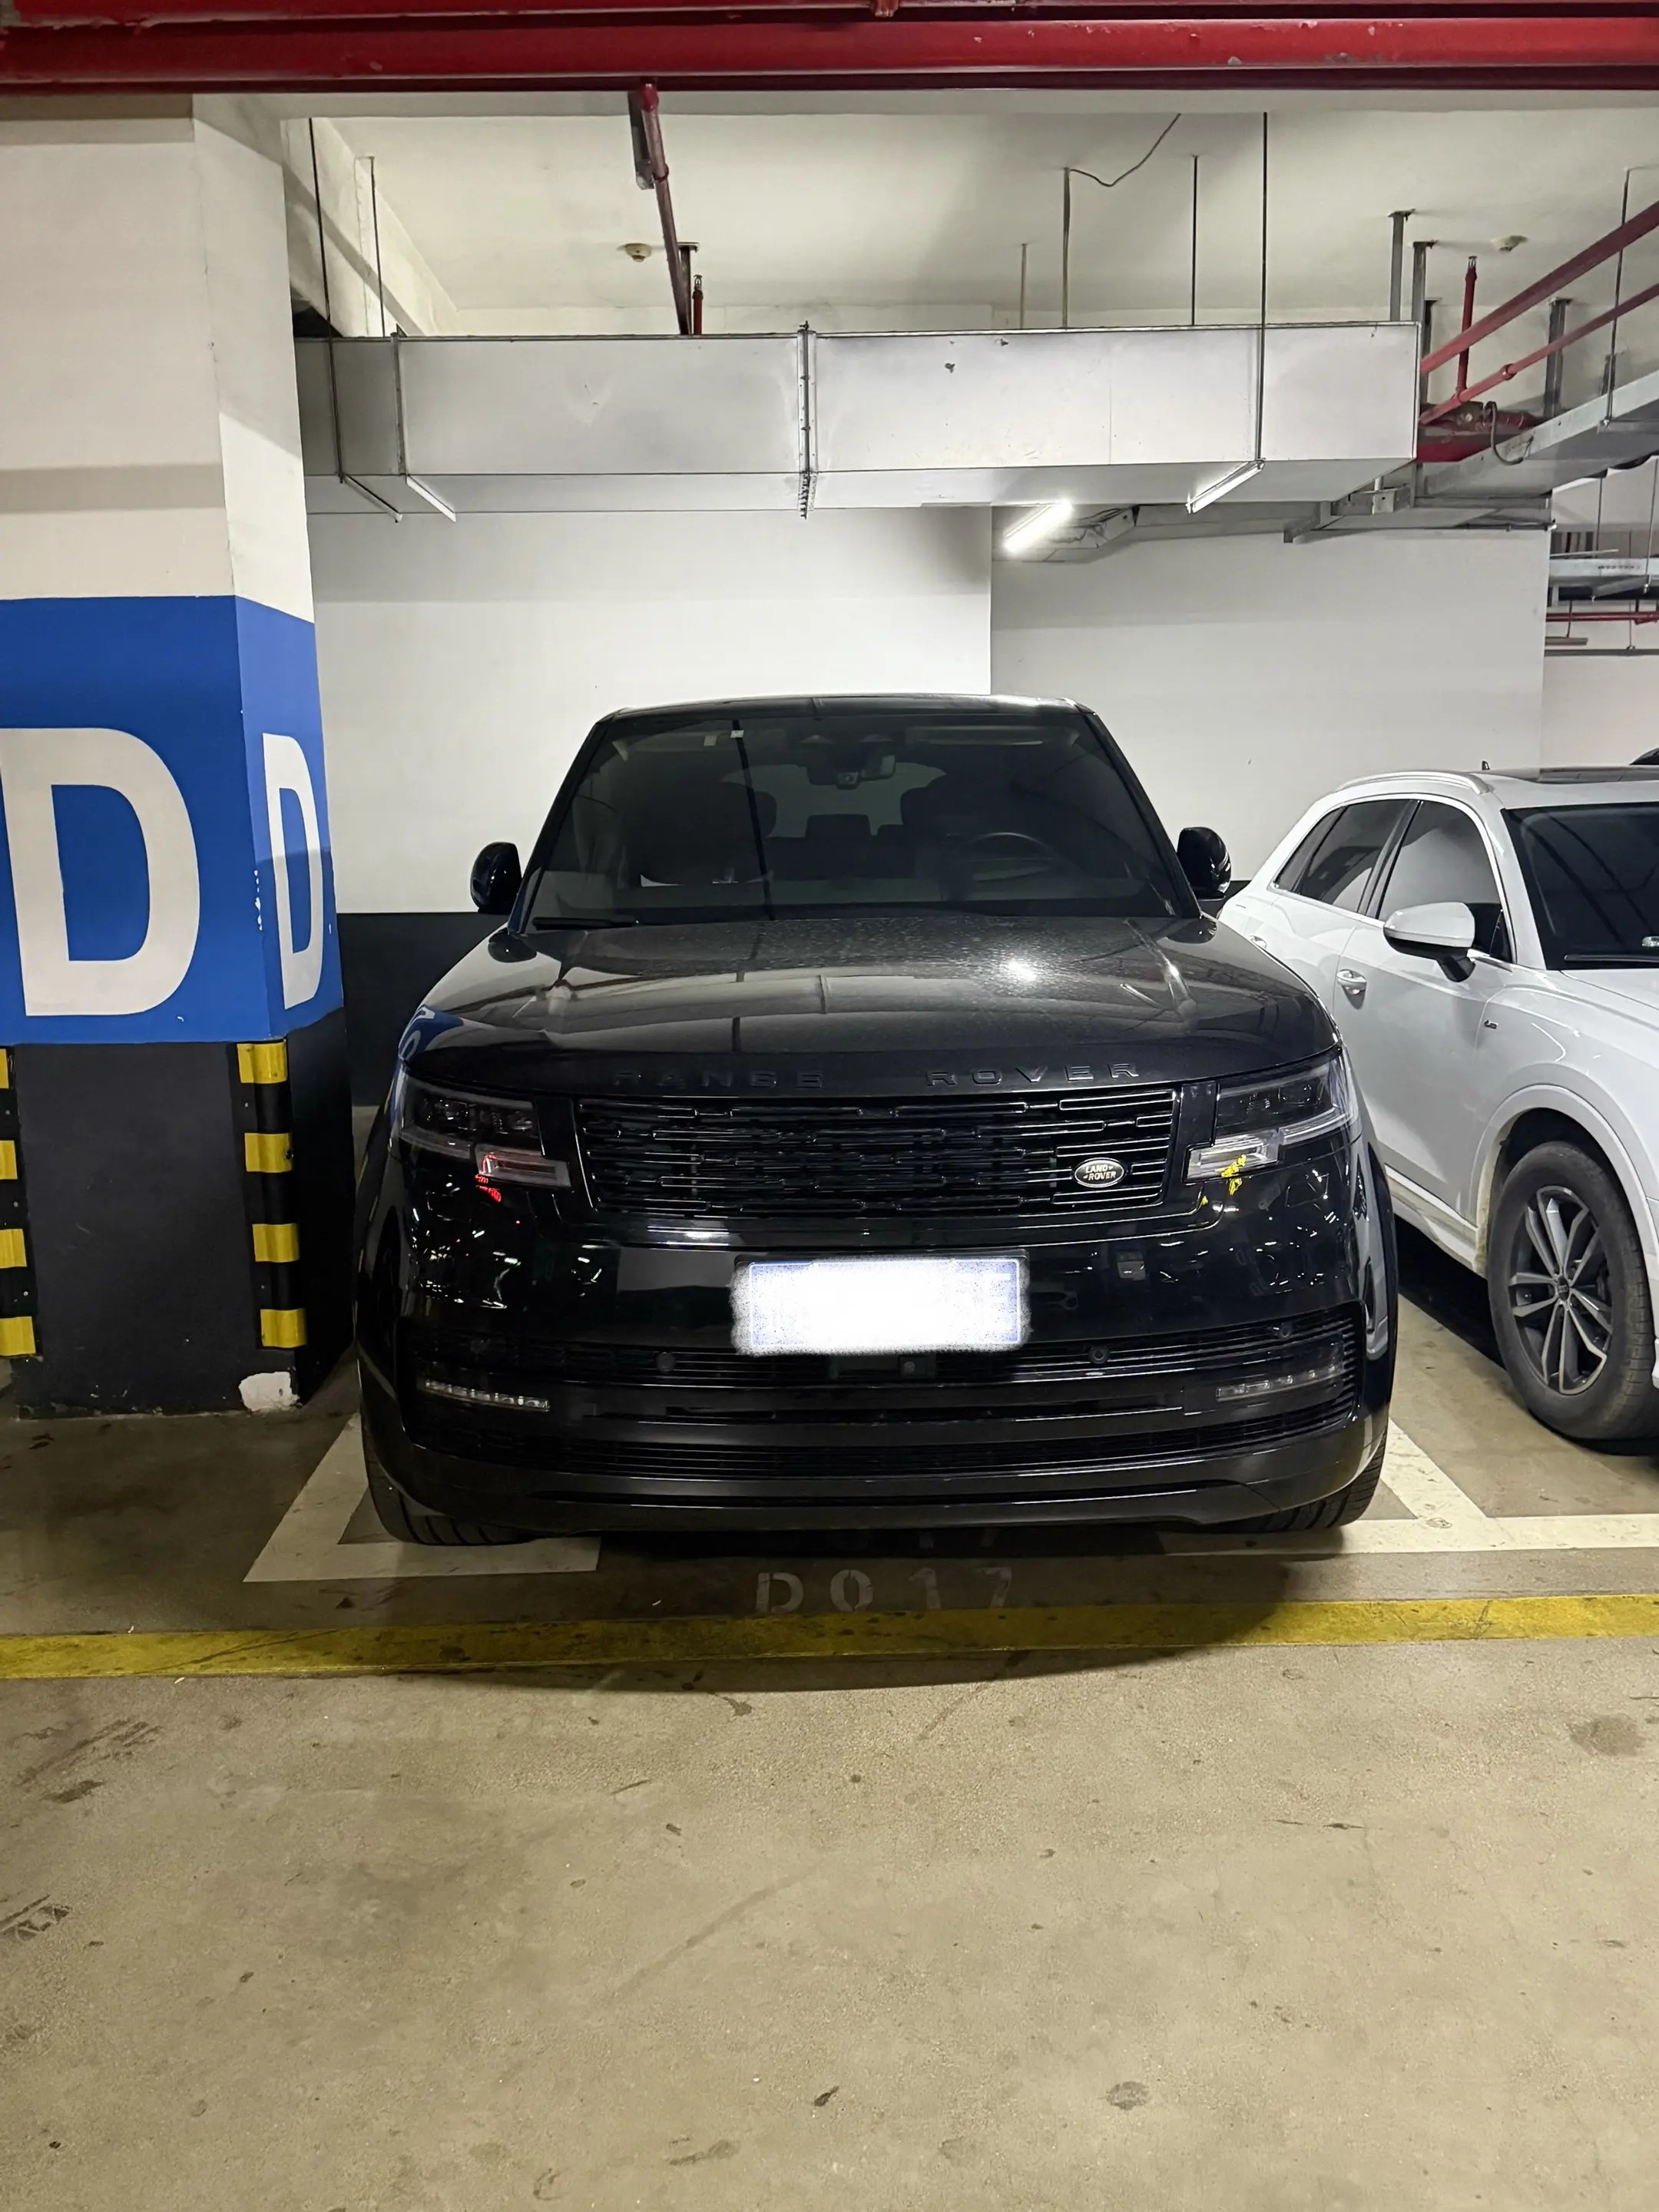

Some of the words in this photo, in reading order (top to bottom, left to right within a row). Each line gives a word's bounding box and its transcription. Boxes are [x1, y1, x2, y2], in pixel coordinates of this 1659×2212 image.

[0, 728, 200, 1016] D
[263, 733, 324, 1009] D
[926, 1063, 1140, 1086] ROVER
[1086, 1164, 1108, 1173] LAND
[1088, 1171, 1116, 1181] ROVER
[755, 1567, 1013, 1614] D017
